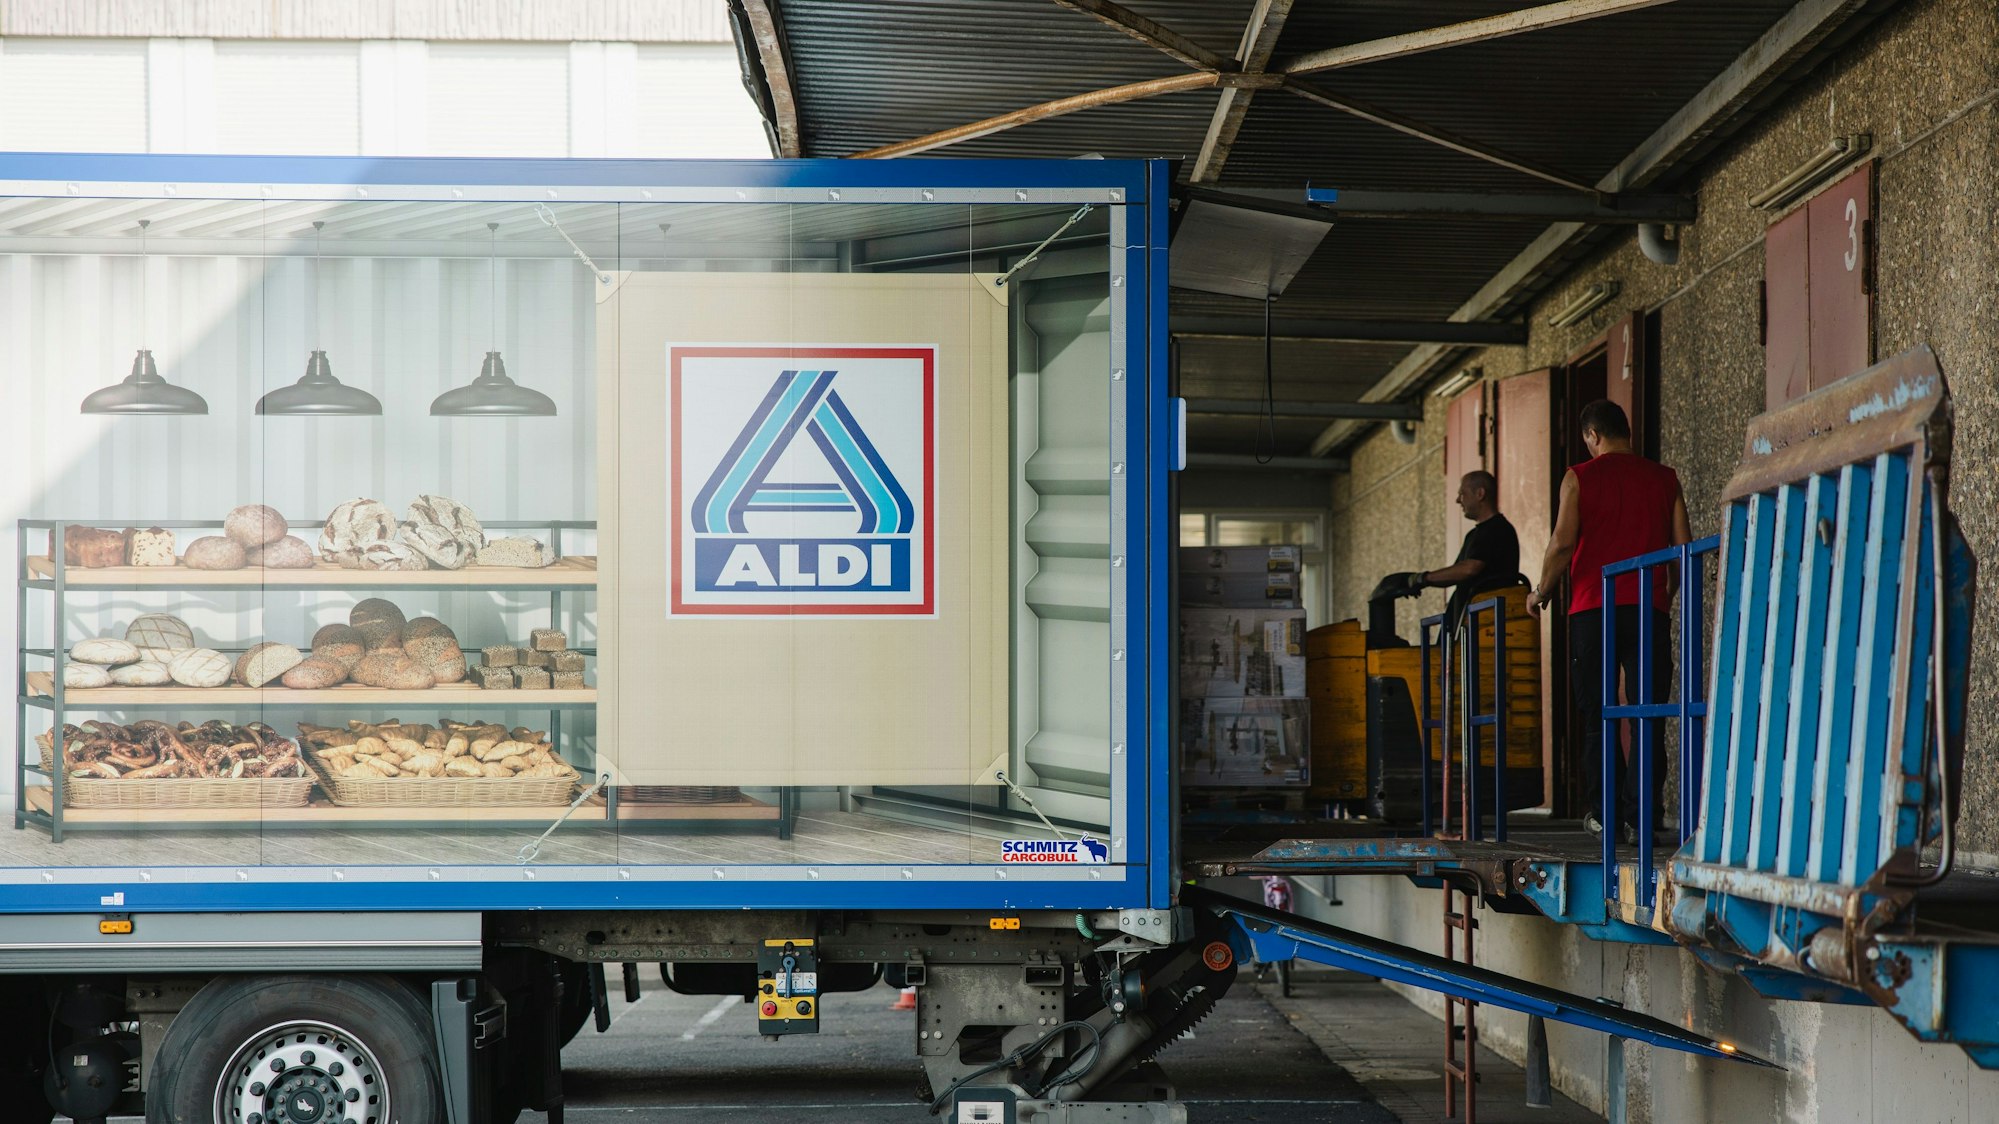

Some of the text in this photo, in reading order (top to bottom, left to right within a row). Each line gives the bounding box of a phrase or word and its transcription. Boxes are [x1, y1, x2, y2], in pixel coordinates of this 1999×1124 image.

[1844, 198, 1857, 272] 3
[1622, 324, 1629, 380] 2
[714, 543, 892, 587] ALDI
[1002, 841, 1078, 853] SCHMITZ
[1002, 853, 1078, 862] CARGOBULL
